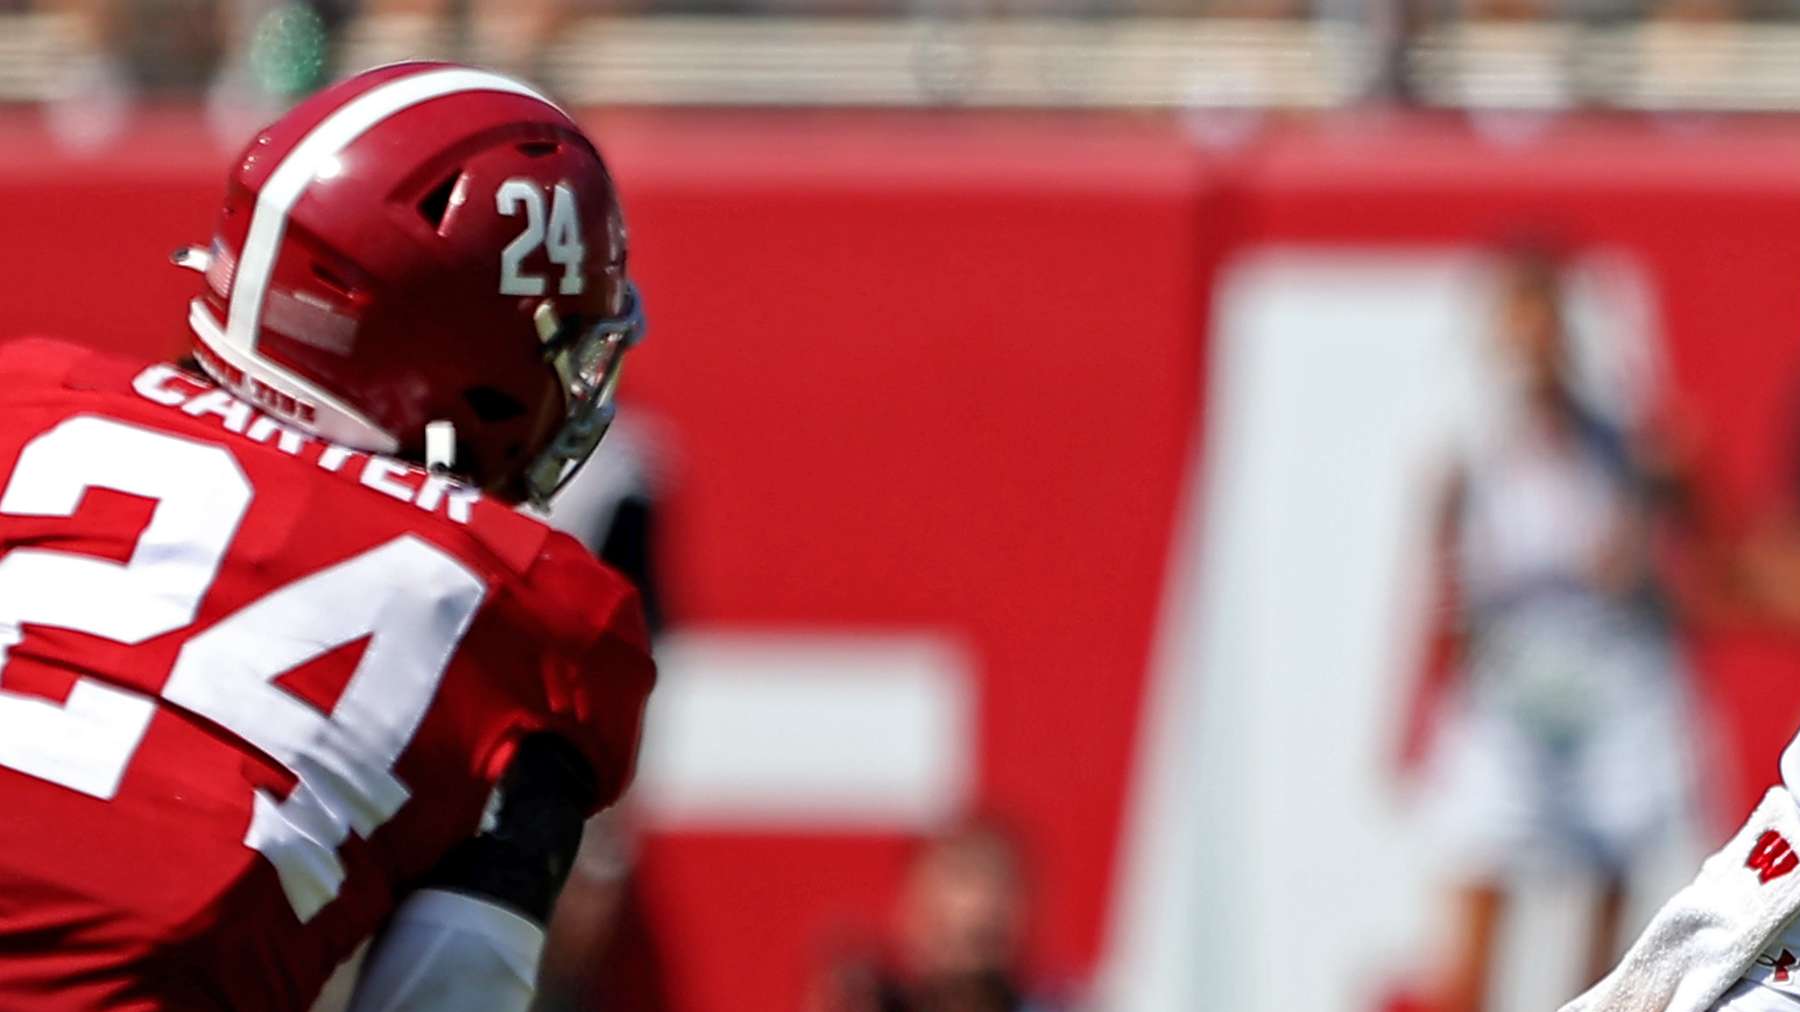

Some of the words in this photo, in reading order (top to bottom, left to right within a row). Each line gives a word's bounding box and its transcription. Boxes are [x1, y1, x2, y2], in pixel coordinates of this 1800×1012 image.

[496, 180, 584, 295] 24
[0, 414, 487, 924] 24
[1744, 828, 1800, 886] W
